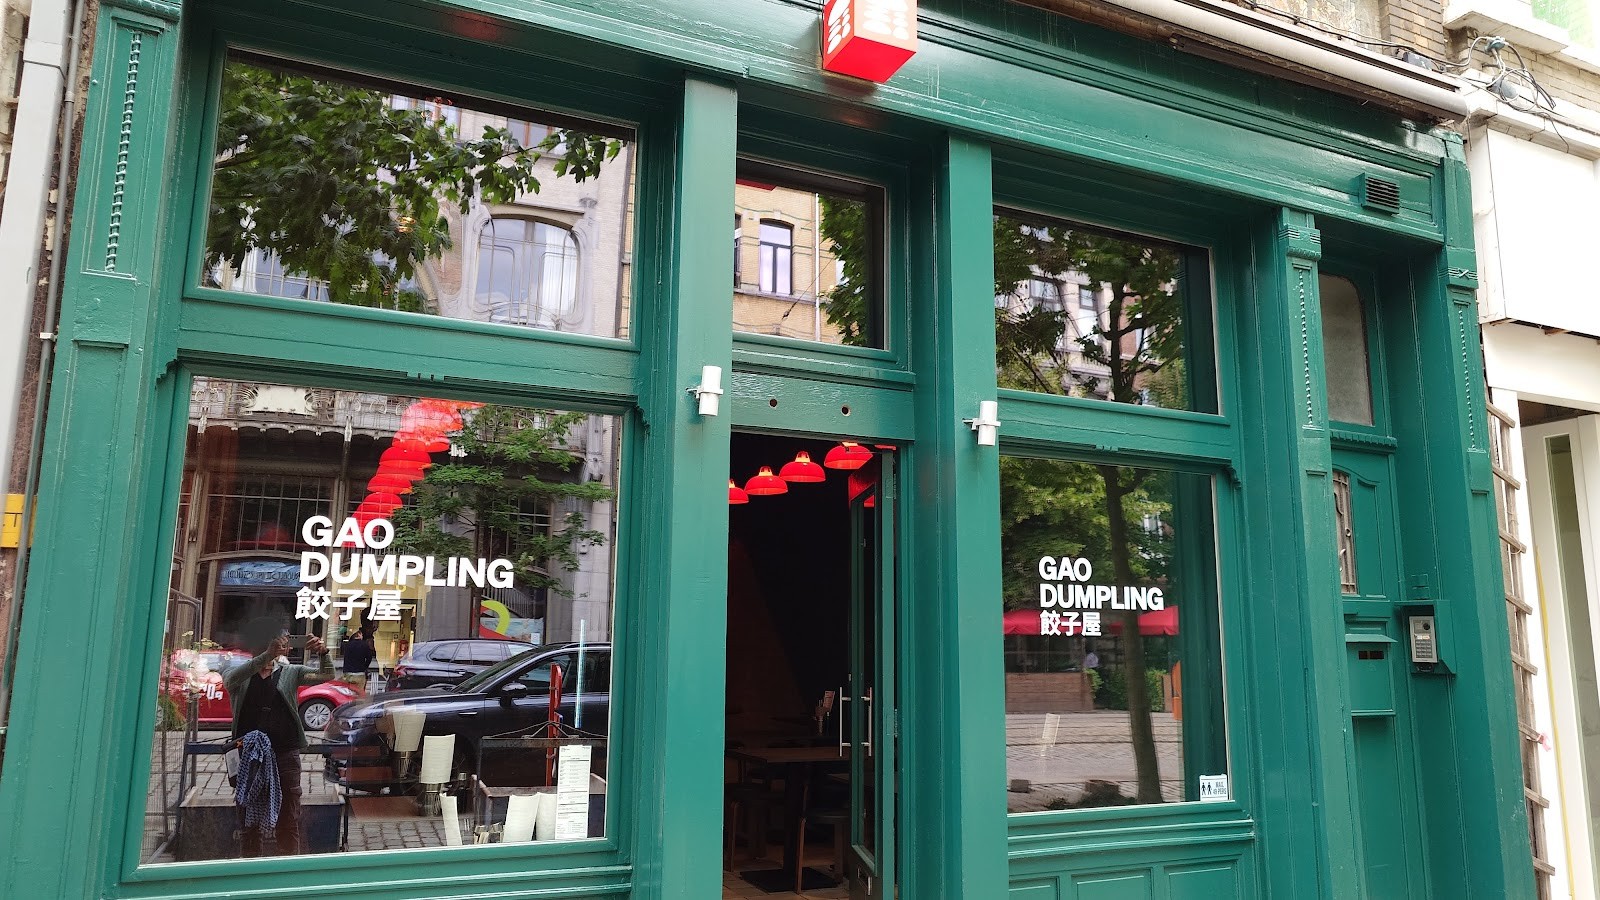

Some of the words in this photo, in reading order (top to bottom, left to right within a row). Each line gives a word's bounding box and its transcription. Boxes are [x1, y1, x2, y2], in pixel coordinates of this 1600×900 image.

[302, 515, 394, 549] GAO
[299, 551, 514, 589] DUMPLING
[1039, 556, 1092, 582] GAO
[295, 585, 402, 621] 餃子屋
[1040, 583, 1164, 610] DUMPLING
[1040, 610, 1101, 636] 餃子屋
